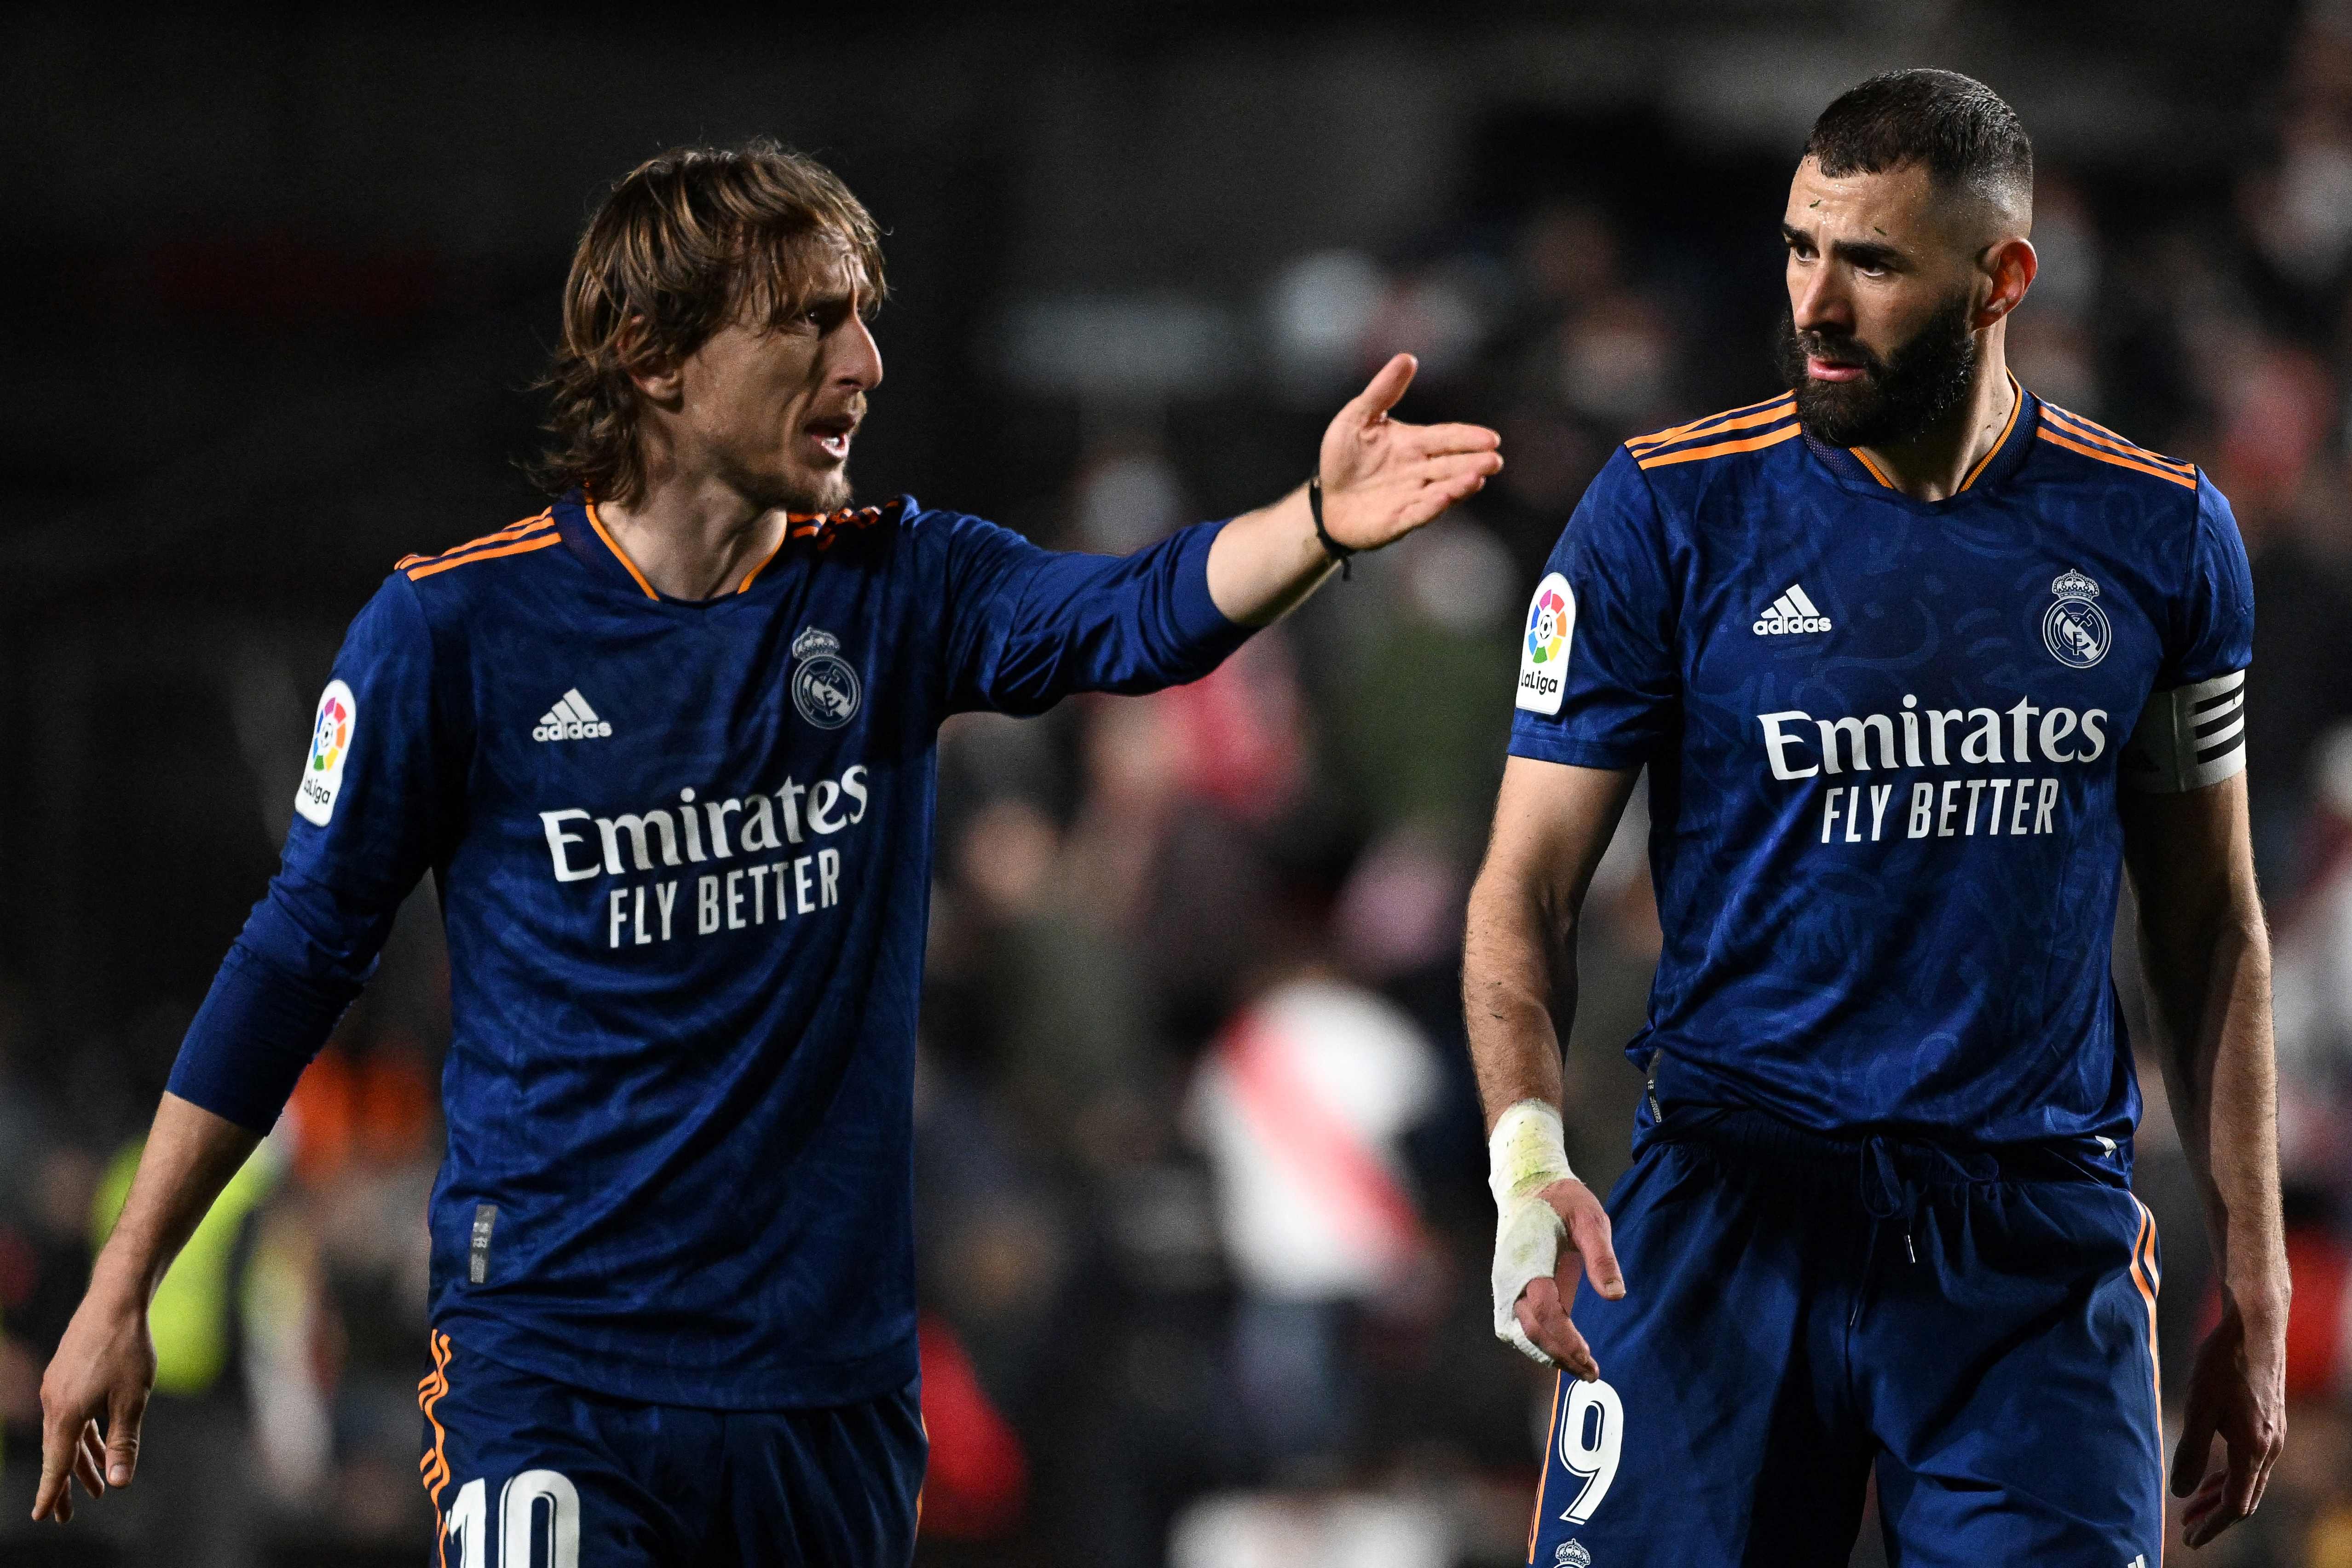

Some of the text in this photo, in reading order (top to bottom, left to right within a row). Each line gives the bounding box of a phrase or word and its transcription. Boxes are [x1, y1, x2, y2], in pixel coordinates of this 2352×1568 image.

[1752, 615, 1832, 635] adidas
[1521, 669, 1558, 695] LaLiga
[532, 721, 612, 742] adidas
[1756, 694, 2108, 781] Emirates
[538, 765, 867, 882] Emirates
[1821, 778, 2059, 844] FLY BETTER
[609, 848, 840, 949] FLY BETTER
[1558, 1378, 1624, 1526] 9
[445, 1469, 580, 1568] 10
